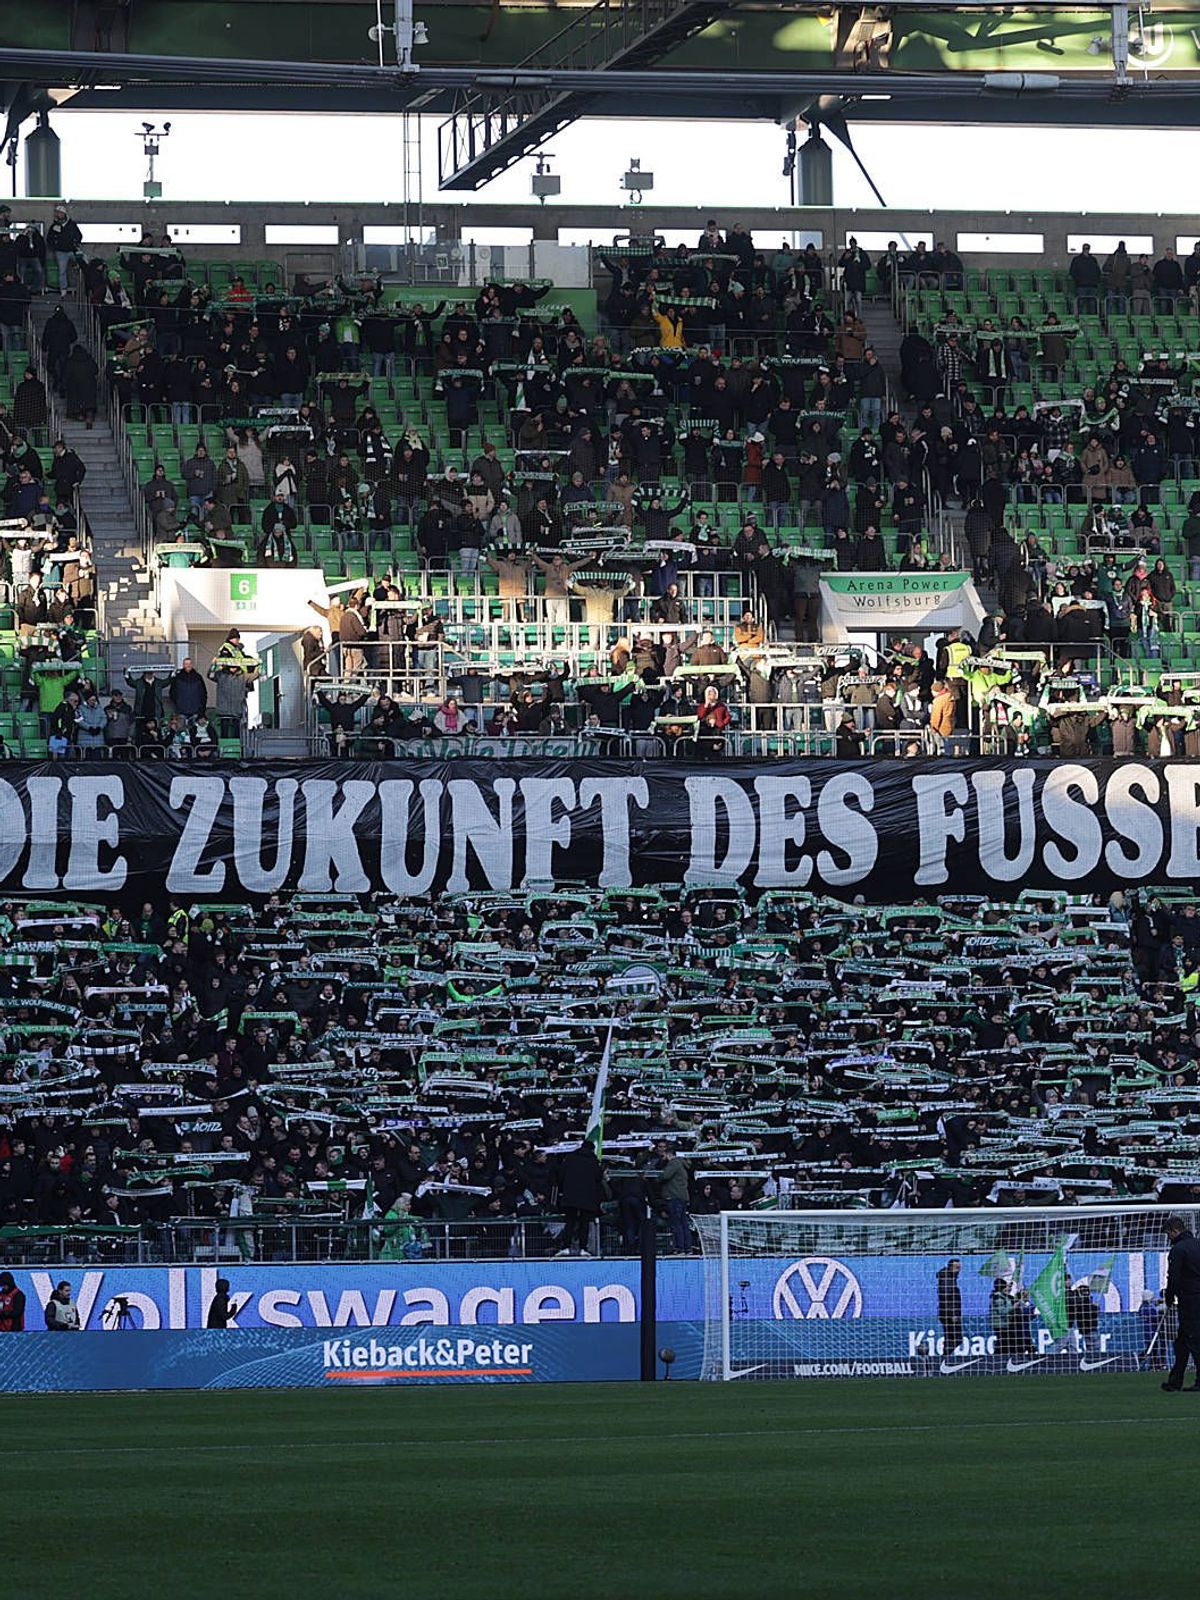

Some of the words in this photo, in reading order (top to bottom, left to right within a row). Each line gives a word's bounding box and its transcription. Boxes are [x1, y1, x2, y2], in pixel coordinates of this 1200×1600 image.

[238, 580, 250, 595] 6
[847, 579, 893, 592] Arena
[903, 578, 949, 590] Power
[853, 595, 941, 608] Wolfsburg
[165, 775, 649, 895] ZUKUNFT
[684, 773, 878, 888] DES
[21, 999, 66, 1012] WOLFSBURG
[30, 1268, 635, 1330] Volkswagen
[323, 1338, 532, 1368] Kieback&Peter
[793, 1362, 914, 1377] NIKE.COM/FOOTBALL
